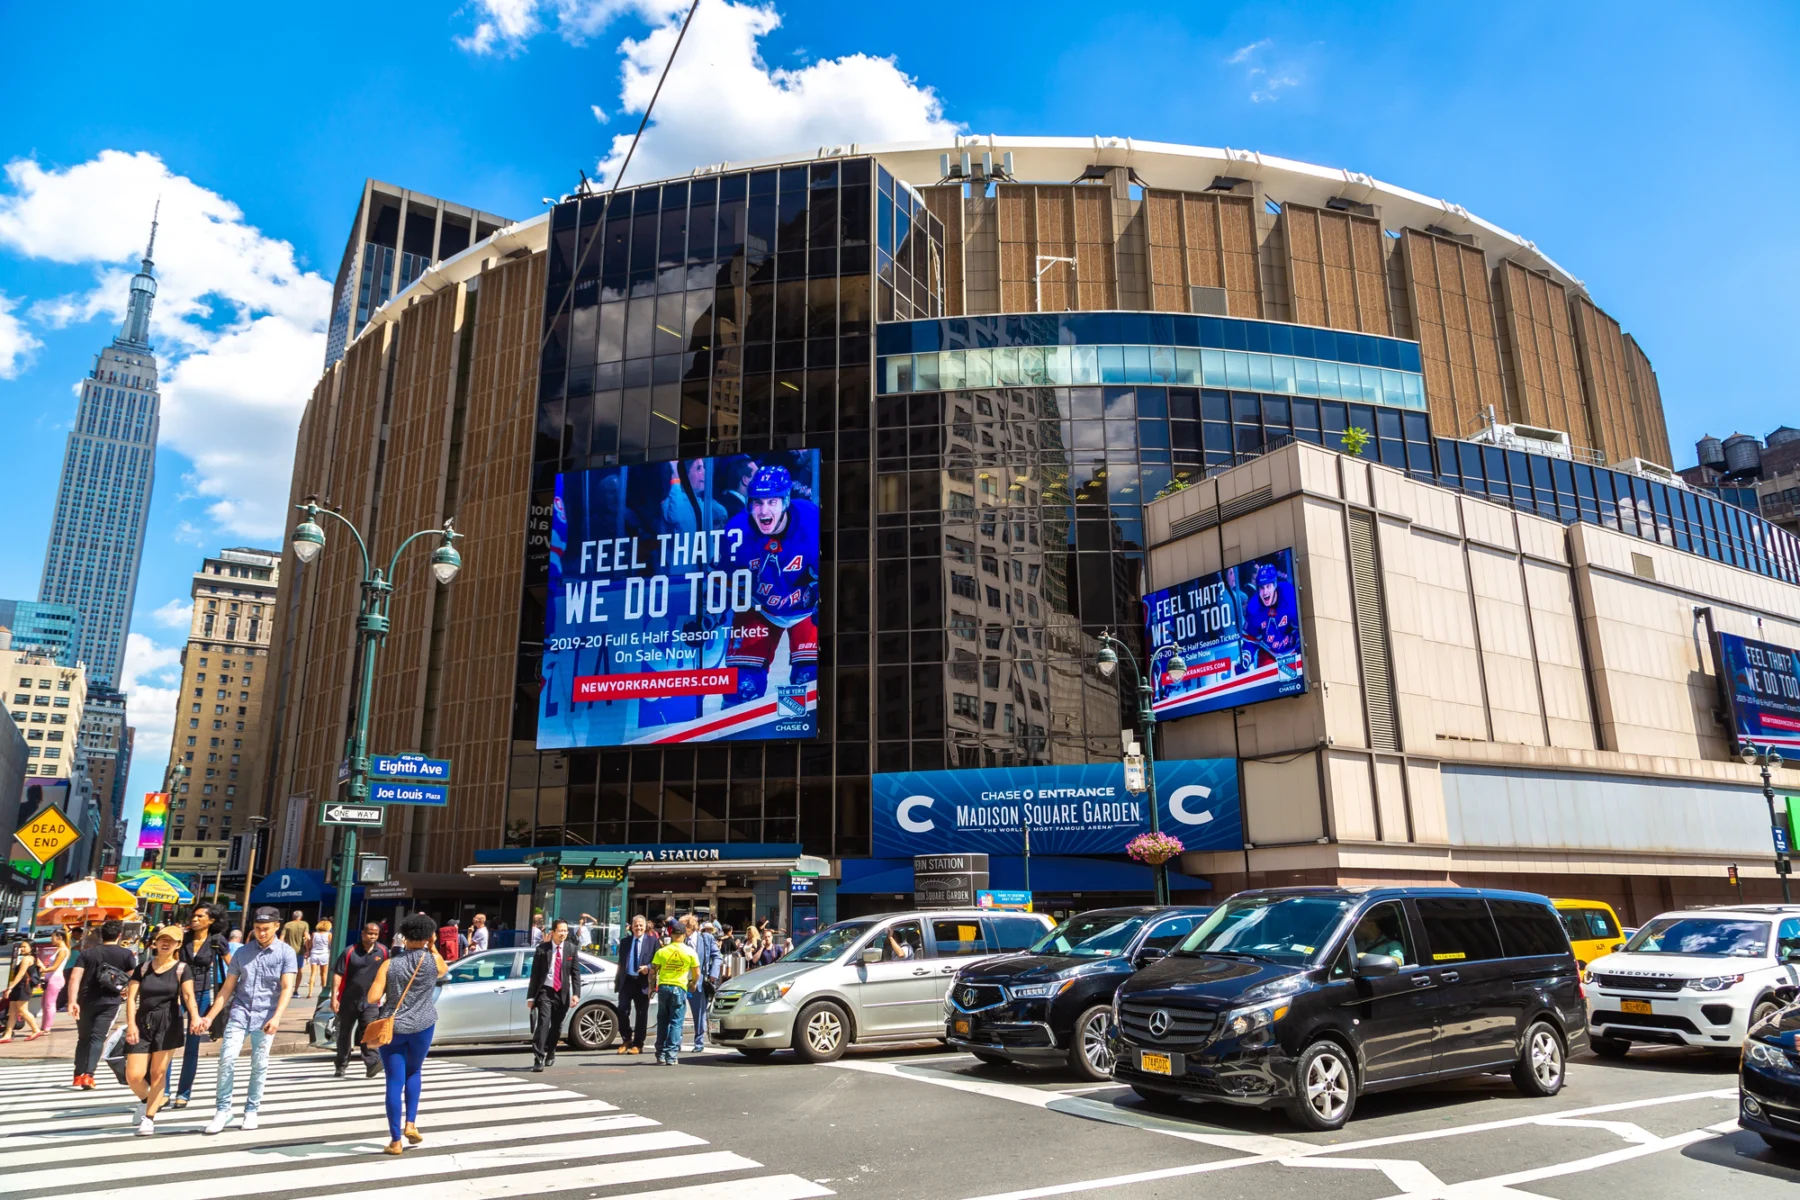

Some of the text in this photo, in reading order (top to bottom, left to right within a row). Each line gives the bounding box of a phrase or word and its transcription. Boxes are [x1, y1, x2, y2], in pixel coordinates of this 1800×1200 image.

[580, 528, 743, 574] FEEL THAT?
[565, 568, 761, 624] WE DO TOO.
[1156, 581, 1225, 620] FEEL THAT?
[1151, 603, 1236, 647] WE DO TOO.
[550, 625, 769, 651] 2019-20 Full & Half Season Tickets
[1187, 643, 1199, 652] Half
[1200, 638, 1220, 649] Season
[1220, 633, 1241, 643] Tickets
[615, 647, 697, 664] On Sale Now
[1745, 645, 1792, 673] FEEL THAT?
[581, 675, 730, 693] NEWYORKRANGERS.COM
[1744, 667, 1763, 693] WE
[1762, 671, 1779, 696] DO
[380, 760, 442, 775] Eighth Ave
[376, 787, 394, 798] Joe
[397, 788, 423, 799] Louis
[981, 787, 1115, 801] CHASE ENTRANCE
[1168, 784, 1215, 825] C
[334, 809, 375, 818] ONE WAY
[895, 795, 937, 834] C
[956, 805, 1019, 827] MADISON
[1023, 802, 1079, 826] SQUARE
[32, 824, 66, 834] DEAD
[34, 838, 59, 847] END
[659, 848, 719, 861] STATION
[928, 857, 964, 870] STATION
[280, 874, 291, 890] D
[595, 870, 617, 879] TAXI
[141, 891, 175, 901] ABRETT
[946, 889, 969, 900] GARDEN
[1608, 969, 1674, 977] DISCOVERY
